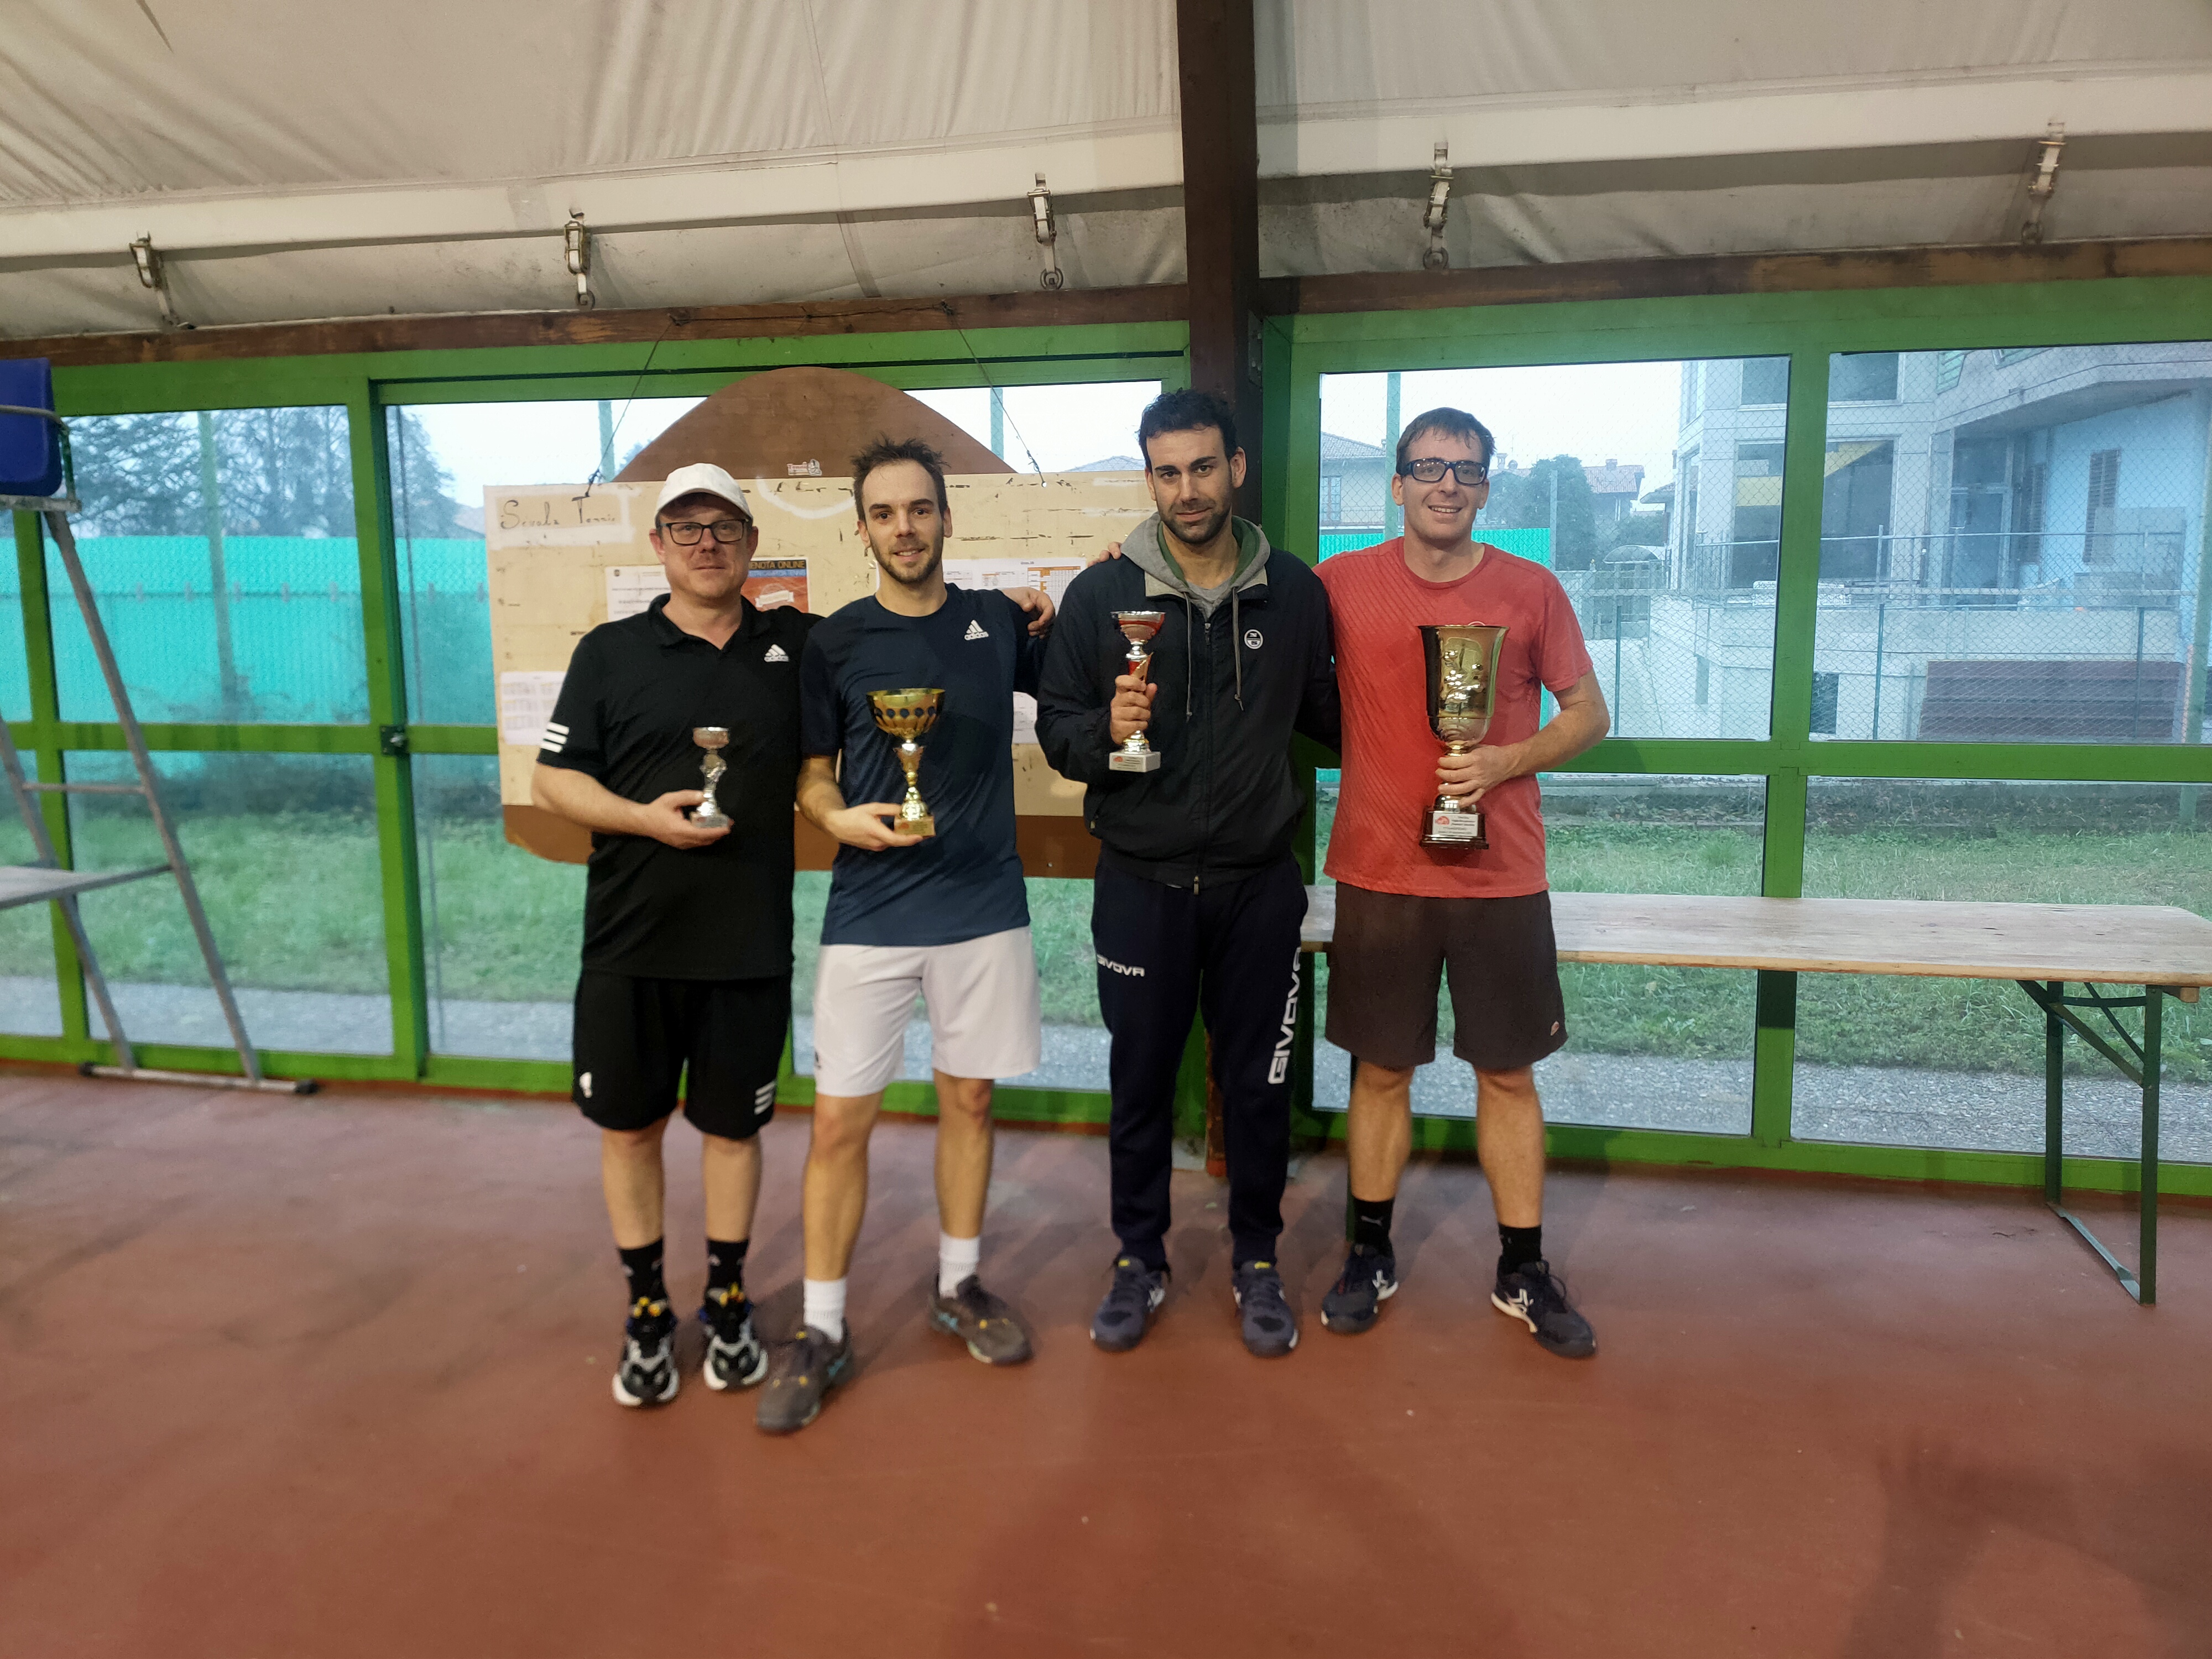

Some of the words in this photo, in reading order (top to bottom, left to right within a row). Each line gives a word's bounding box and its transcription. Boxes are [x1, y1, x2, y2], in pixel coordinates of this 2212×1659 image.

[572, 495, 615, 524] Tennis
[777, 560, 805, 569] ONLINE
[963, 631, 989, 640] adidas
